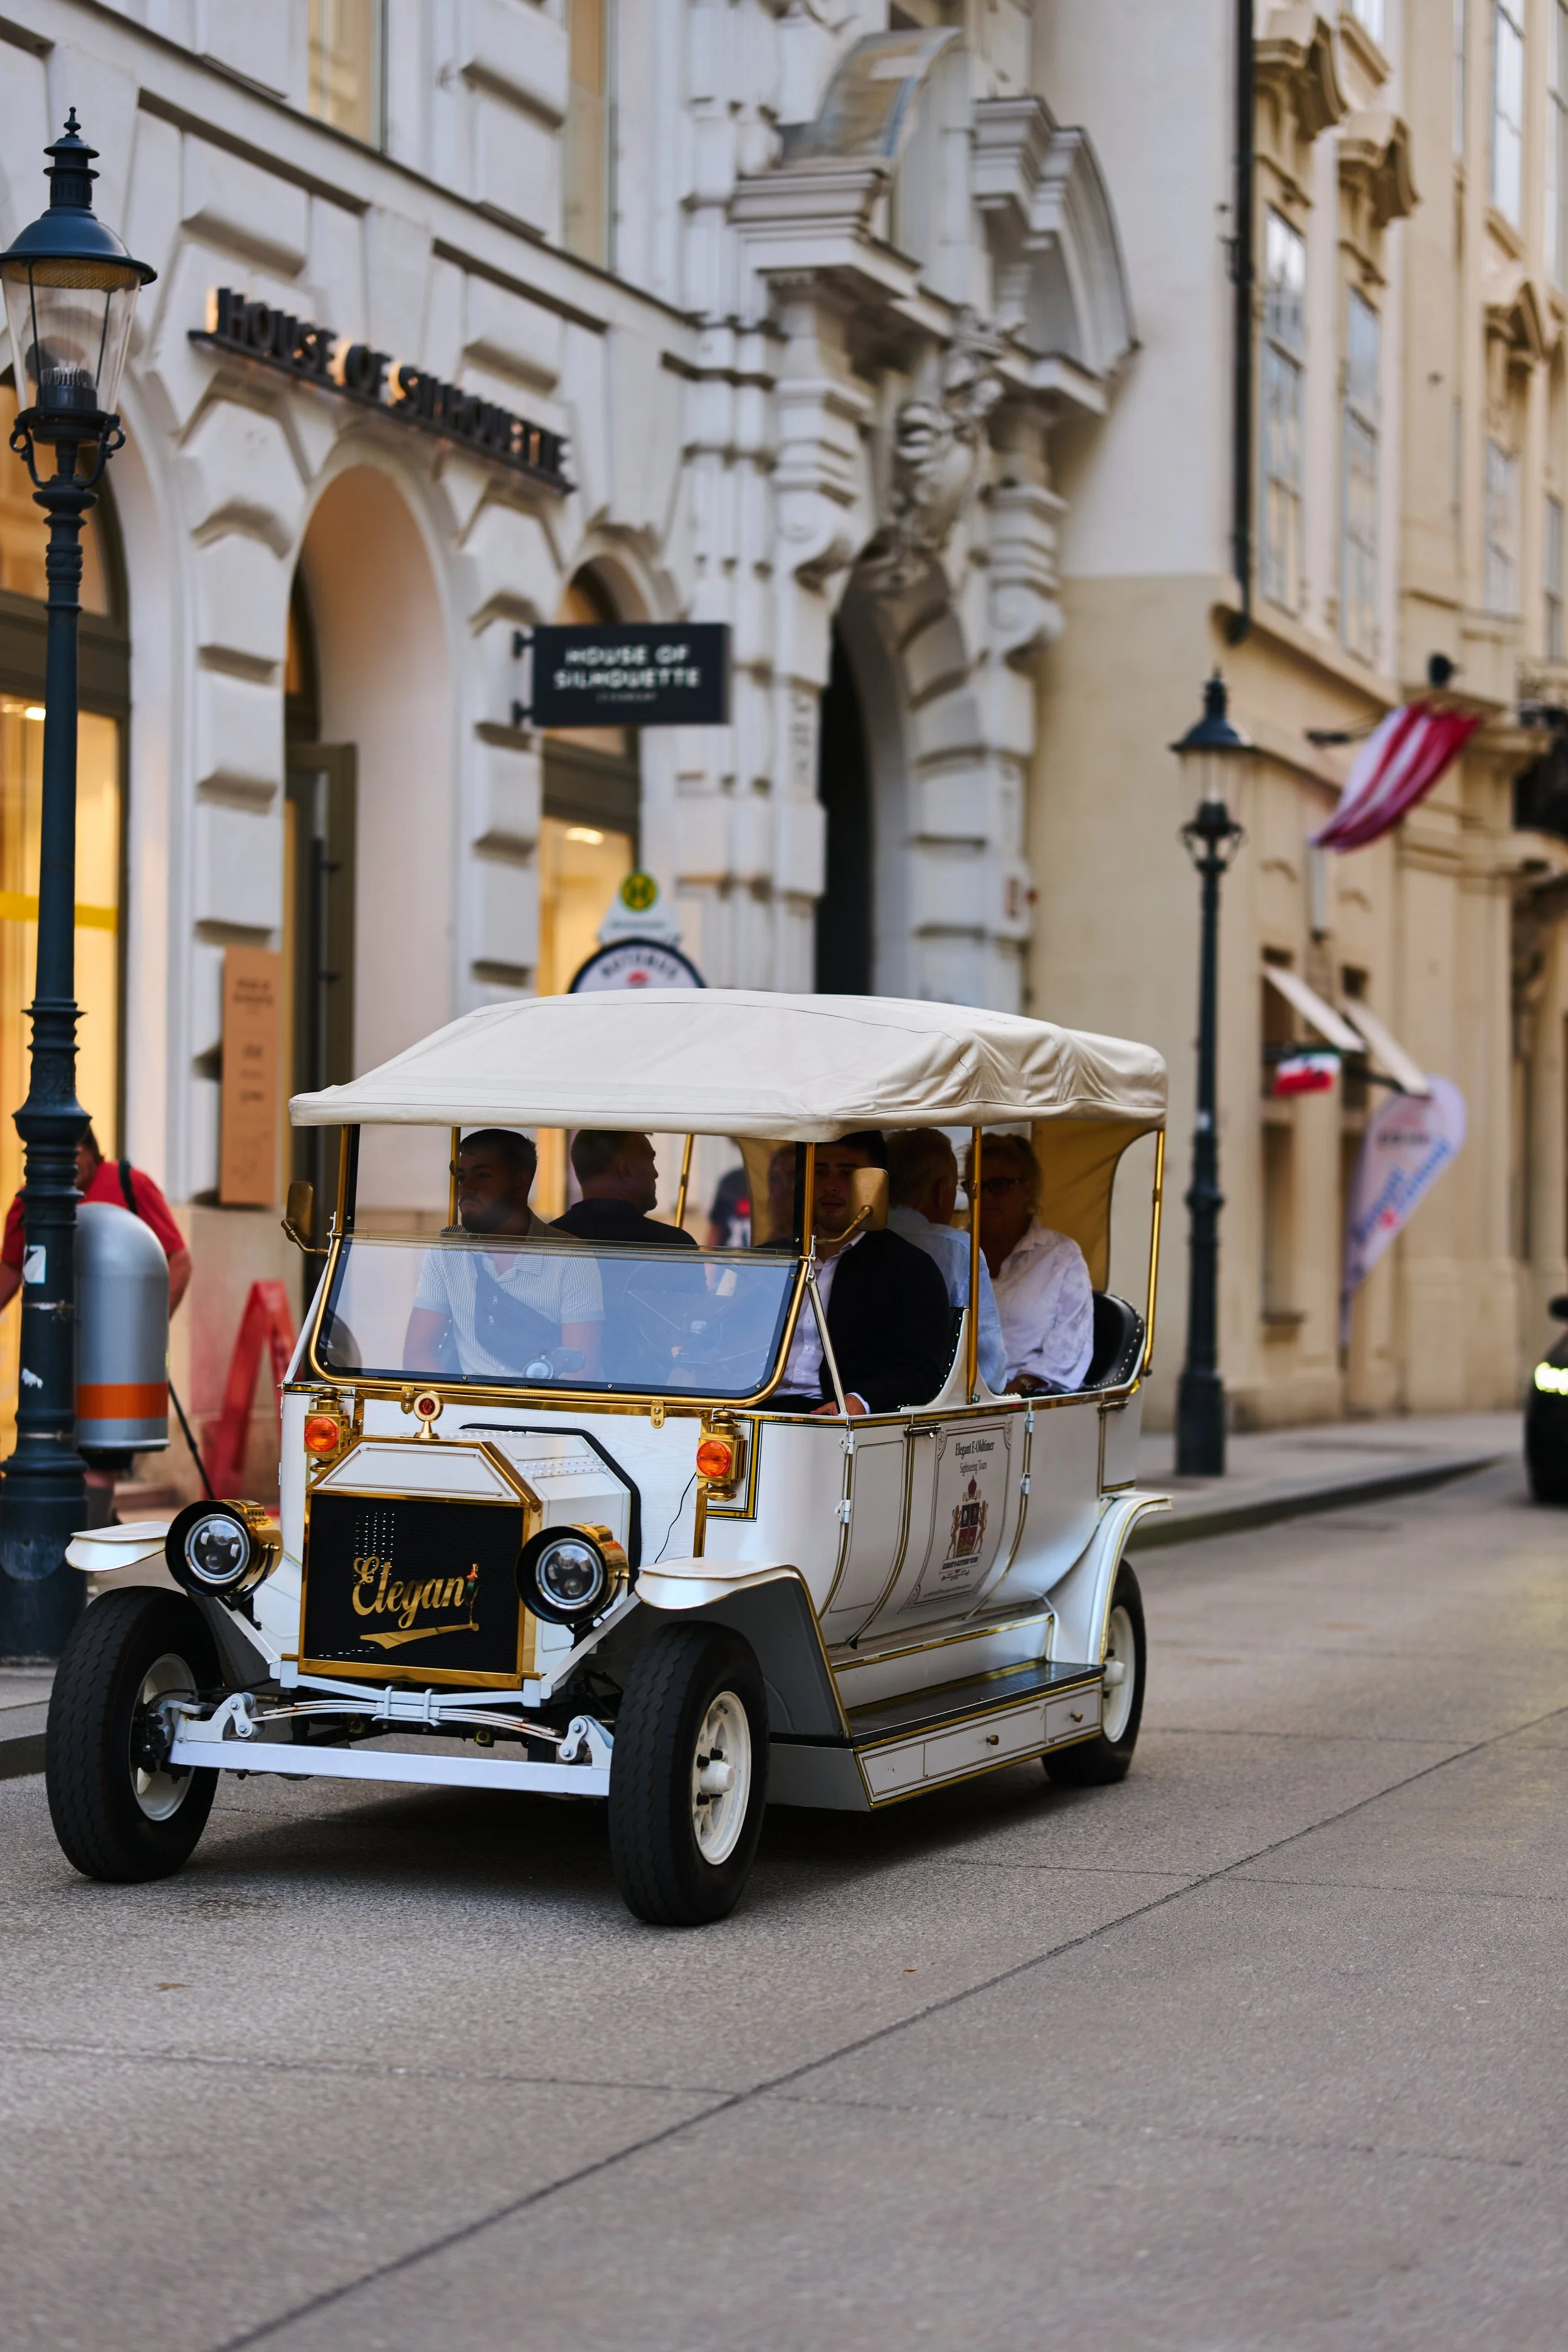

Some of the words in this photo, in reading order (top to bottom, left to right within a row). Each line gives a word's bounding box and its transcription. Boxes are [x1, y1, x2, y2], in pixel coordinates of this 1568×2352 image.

[207, 287, 336, 376] HOUSE
[339, 344, 393, 398] OF
[565, 645, 649, 665] HOUSE
[655, 644, 691, 665] OF
[554, 667, 701, 689] SILHOUETTE
[955, 1441, 972, 1460] Elegant
[972, 1438, 995, 1454] E-Oldtimer
[960, 1461, 978, 1477] Sightseeing
[978, 1459, 988, 1471] Tours
